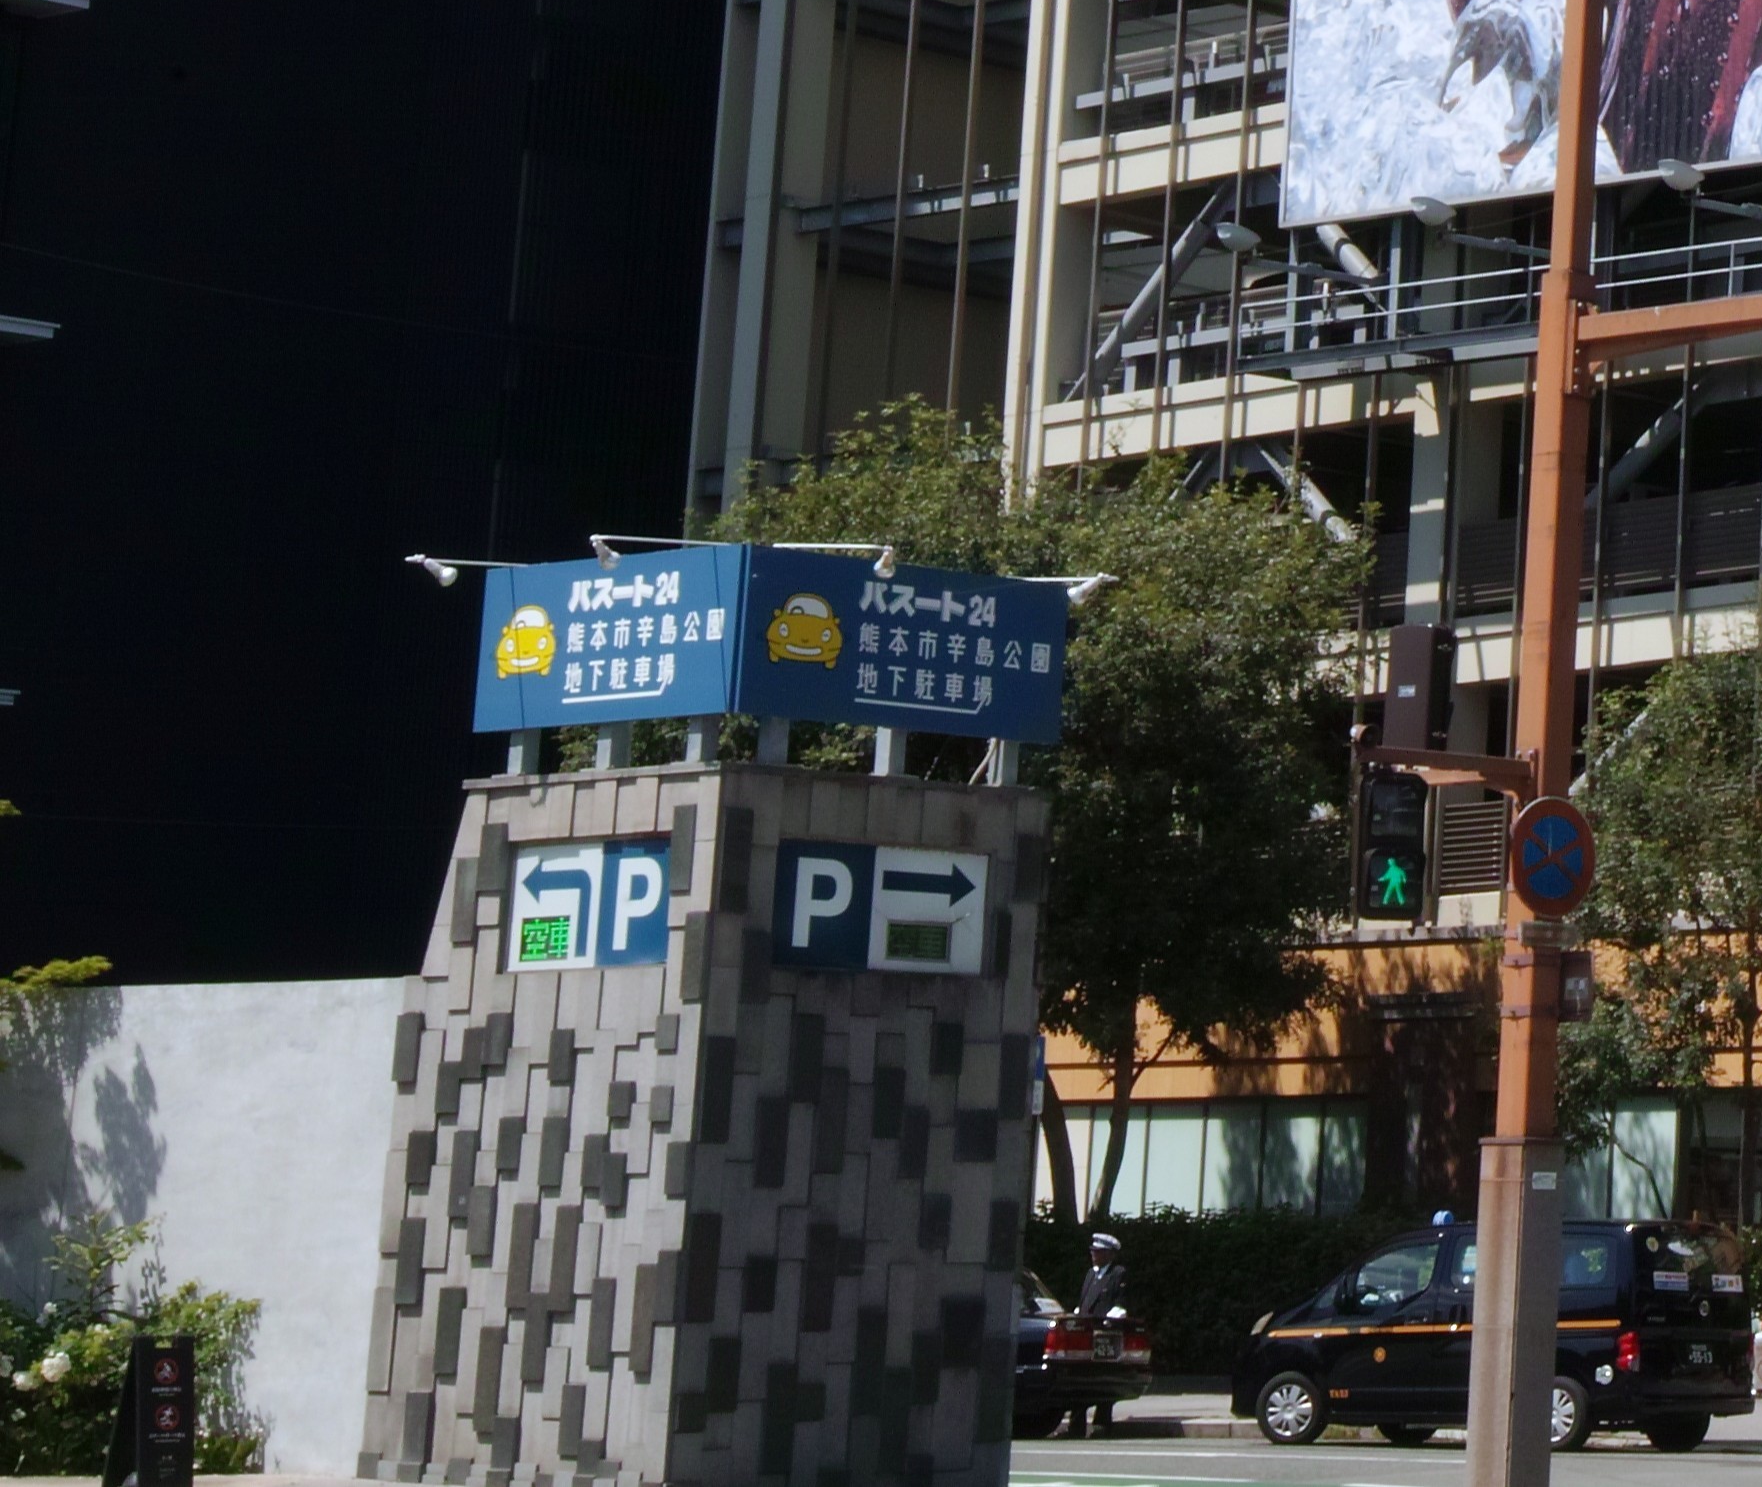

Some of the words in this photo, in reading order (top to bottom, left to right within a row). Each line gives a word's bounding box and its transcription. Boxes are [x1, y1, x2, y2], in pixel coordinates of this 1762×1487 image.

[568, 570, 680, 613] パスート24
[860, 580, 997, 628] パスート24
[565, 607, 725, 654] 熊本市辛島公園
[858, 621, 1051, 674] 熊本市辛島公園
[563, 653, 676, 695] 地下駐車場
[855, 662, 995, 707] 地下駐車場
[612, 856, 663, 951] P
[791, 856, 853, 948] P
[521, 916, 570, 961] 空車
